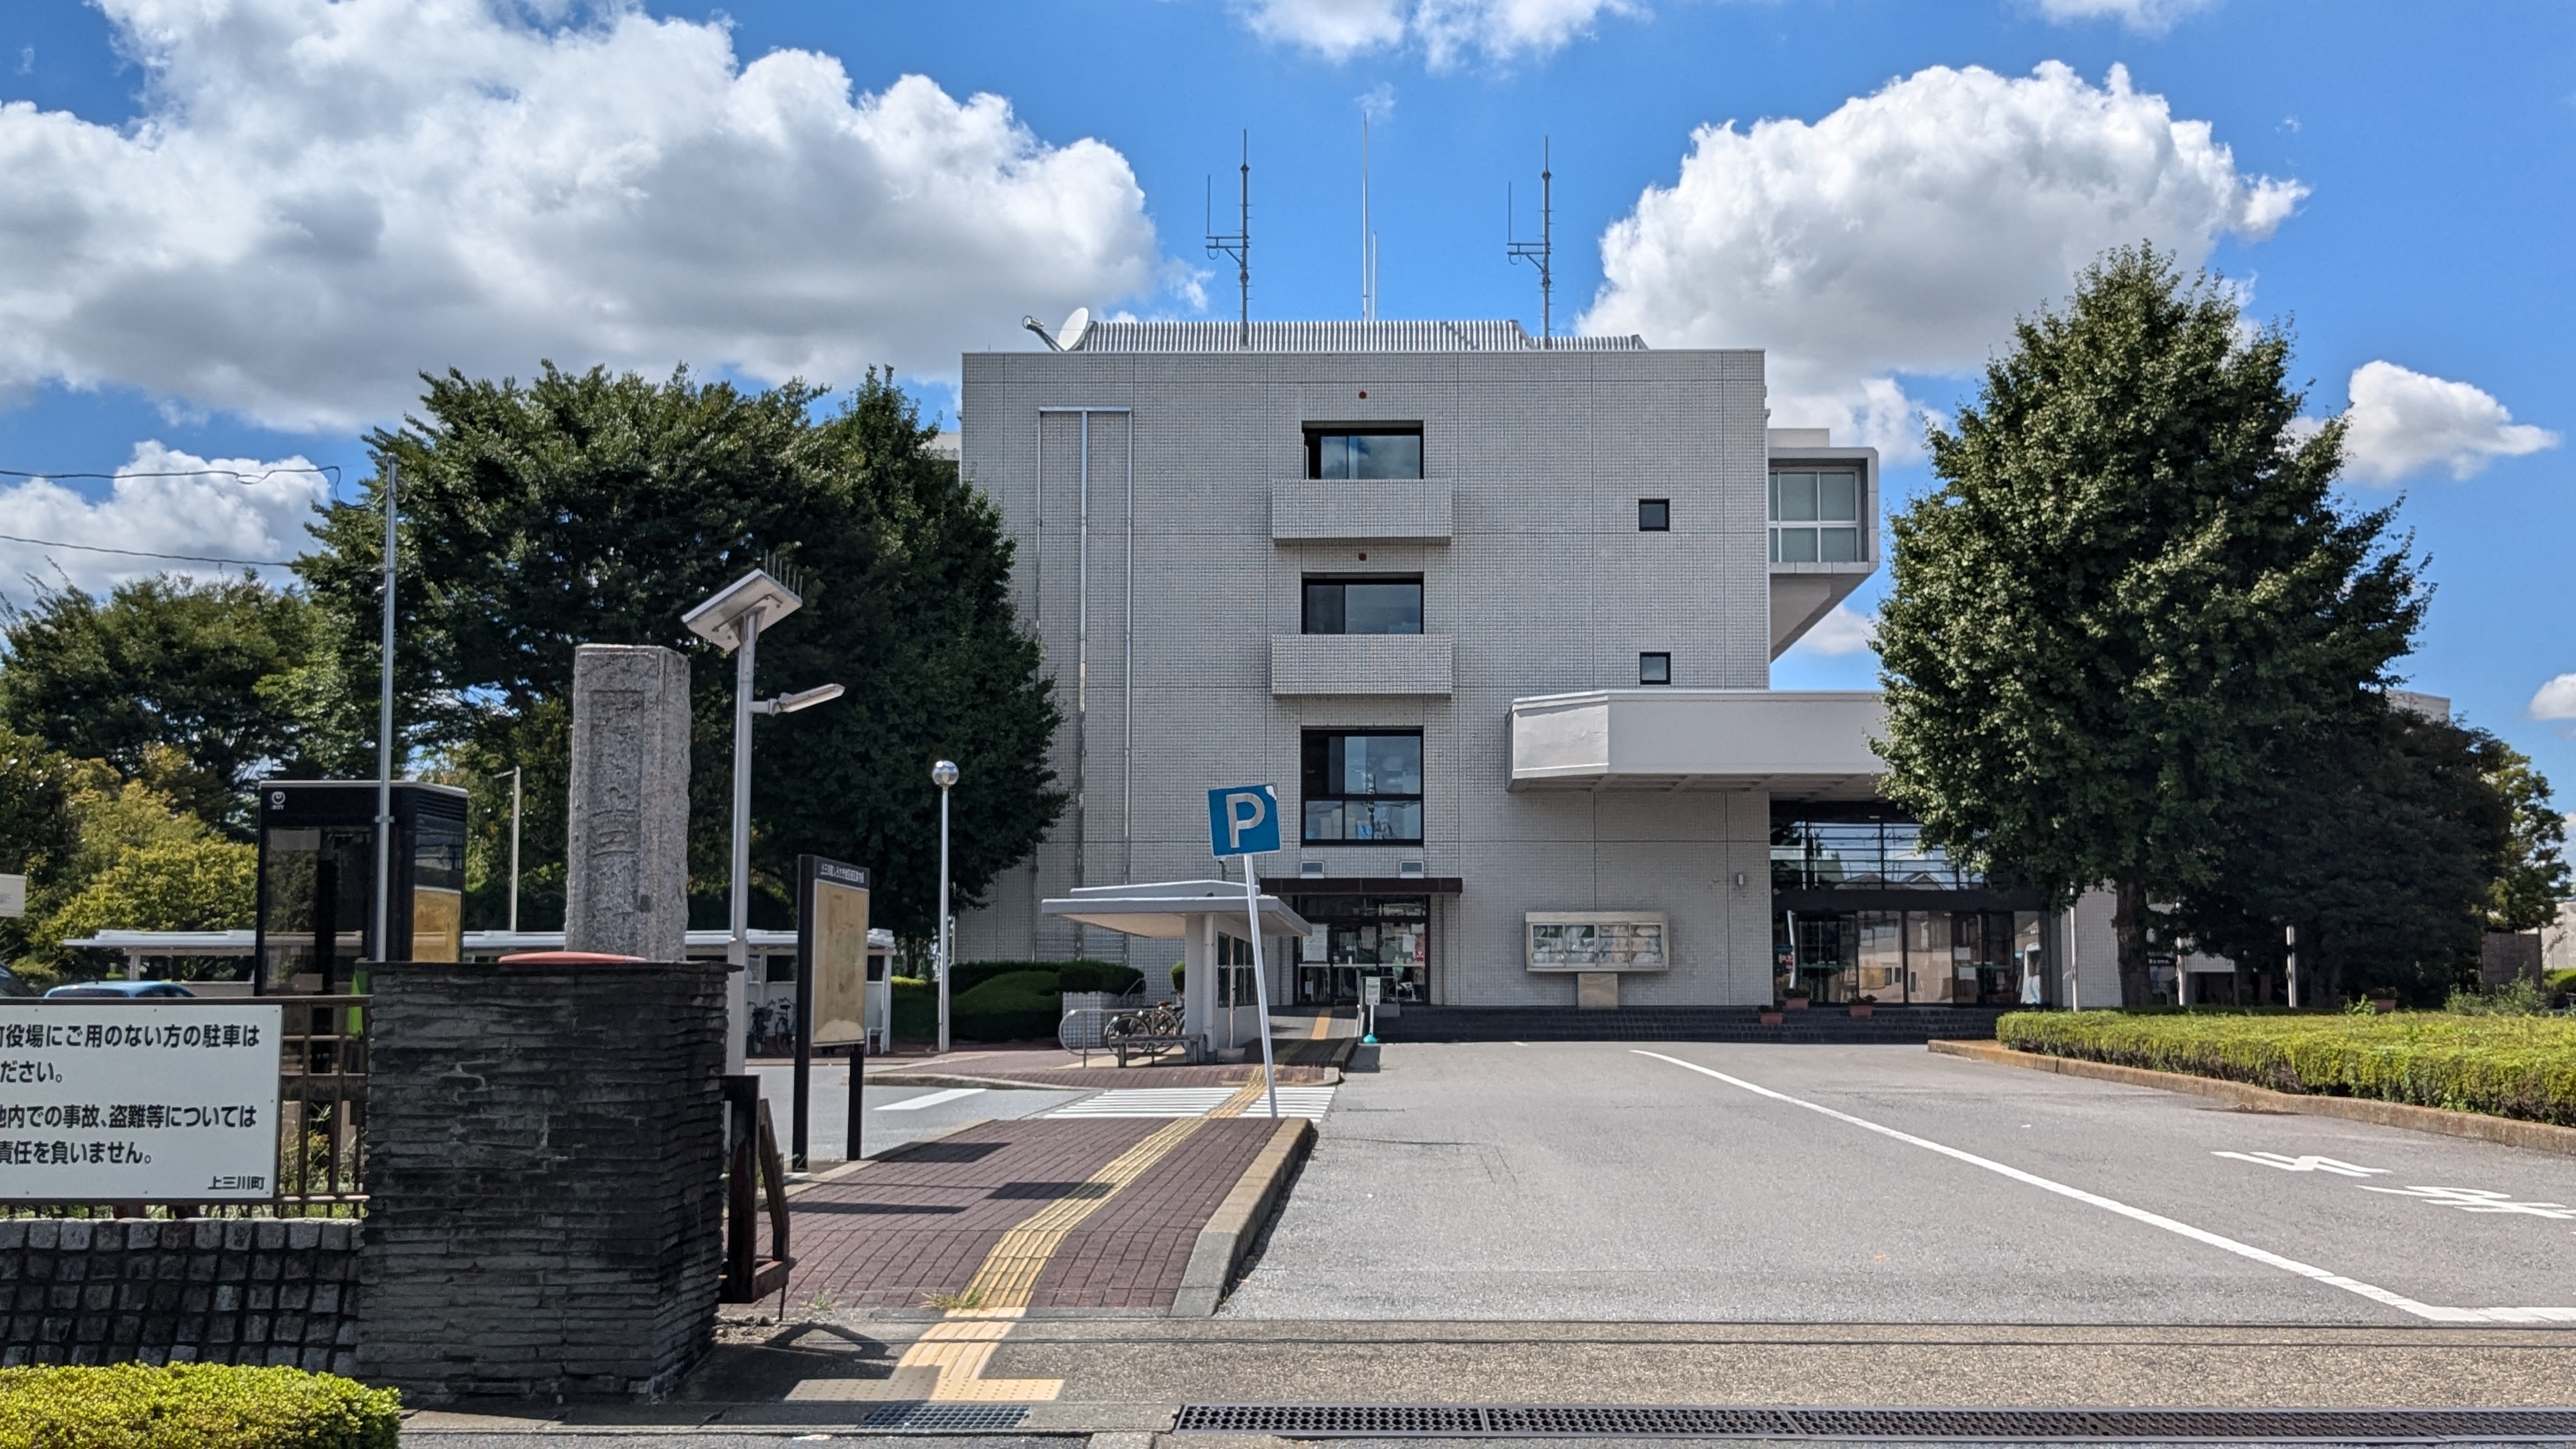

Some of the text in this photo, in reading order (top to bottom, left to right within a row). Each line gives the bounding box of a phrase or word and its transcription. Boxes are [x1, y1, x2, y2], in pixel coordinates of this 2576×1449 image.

[1226, 793, 1265, 848] P
[0, 1140, 151, 1165] 責任を負いません。
[208, 1176, 265, 1190] 上三川町
